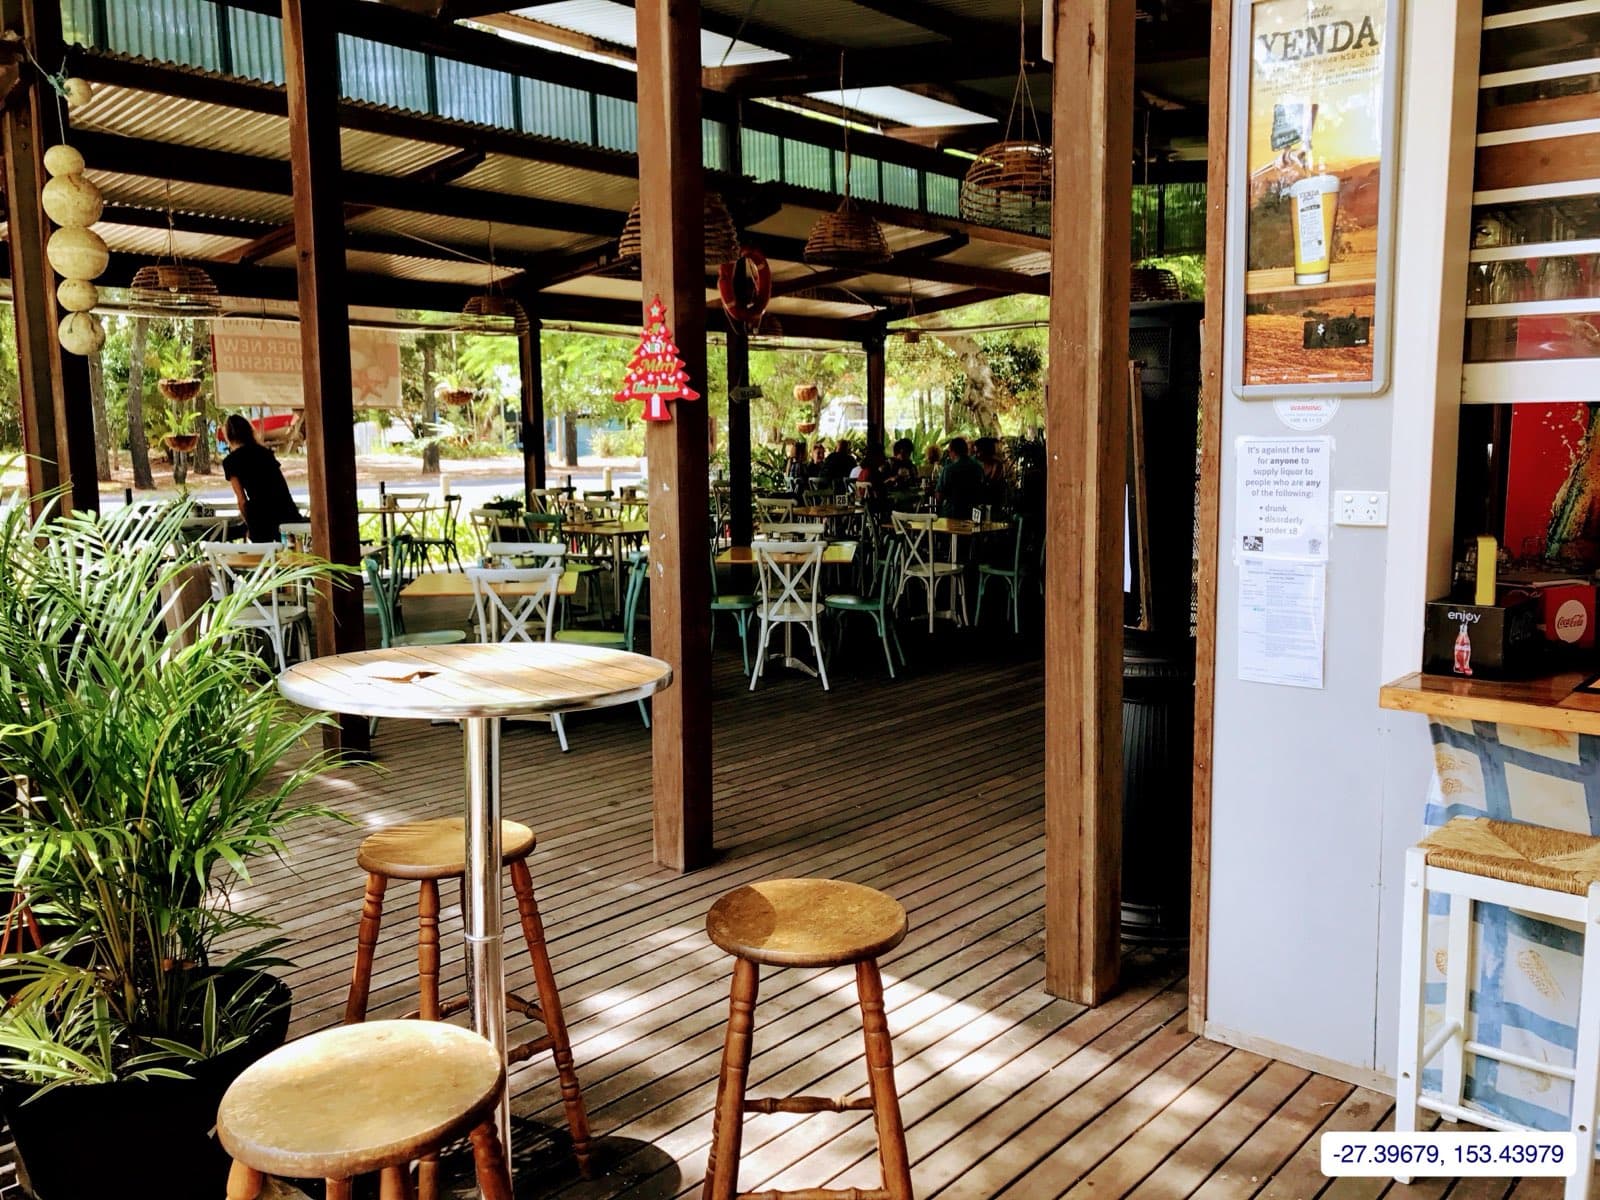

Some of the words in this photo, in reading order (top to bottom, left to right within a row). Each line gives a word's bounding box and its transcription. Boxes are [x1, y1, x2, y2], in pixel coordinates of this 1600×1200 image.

[1258, 15, 1379, 63] YENDA
[1247, 446, 1260, 454] It's
[1261, 446, 1289, 455] against
[1291, 446, 1304, 454] the
[1306, 446, 1320, 454] law
[1257, 457, 1268, 465] for
[1270, 458, 1299, 466] anyone
[1301, 457, 1310, 465] to
[1253, 468, 1279, 476] supply
[1280, 467, 1303, 476] liquor
[1304, 468, 1313, 476] to
[1245, 479, 1271, 487] people
[1305, 480, 1321, 488] any
[1251, 489, 1259, 497] of
[1261, 489, 1274, 497] the
[1264, 504, 1287, 512] drunk
[1264, 515, 1304, 525] disorderly
[1264, 527, 1287, 535] under
[1447, 610, 1481, 624] enjoy
[1557, 614, 1584, 630] Coca-Cola
